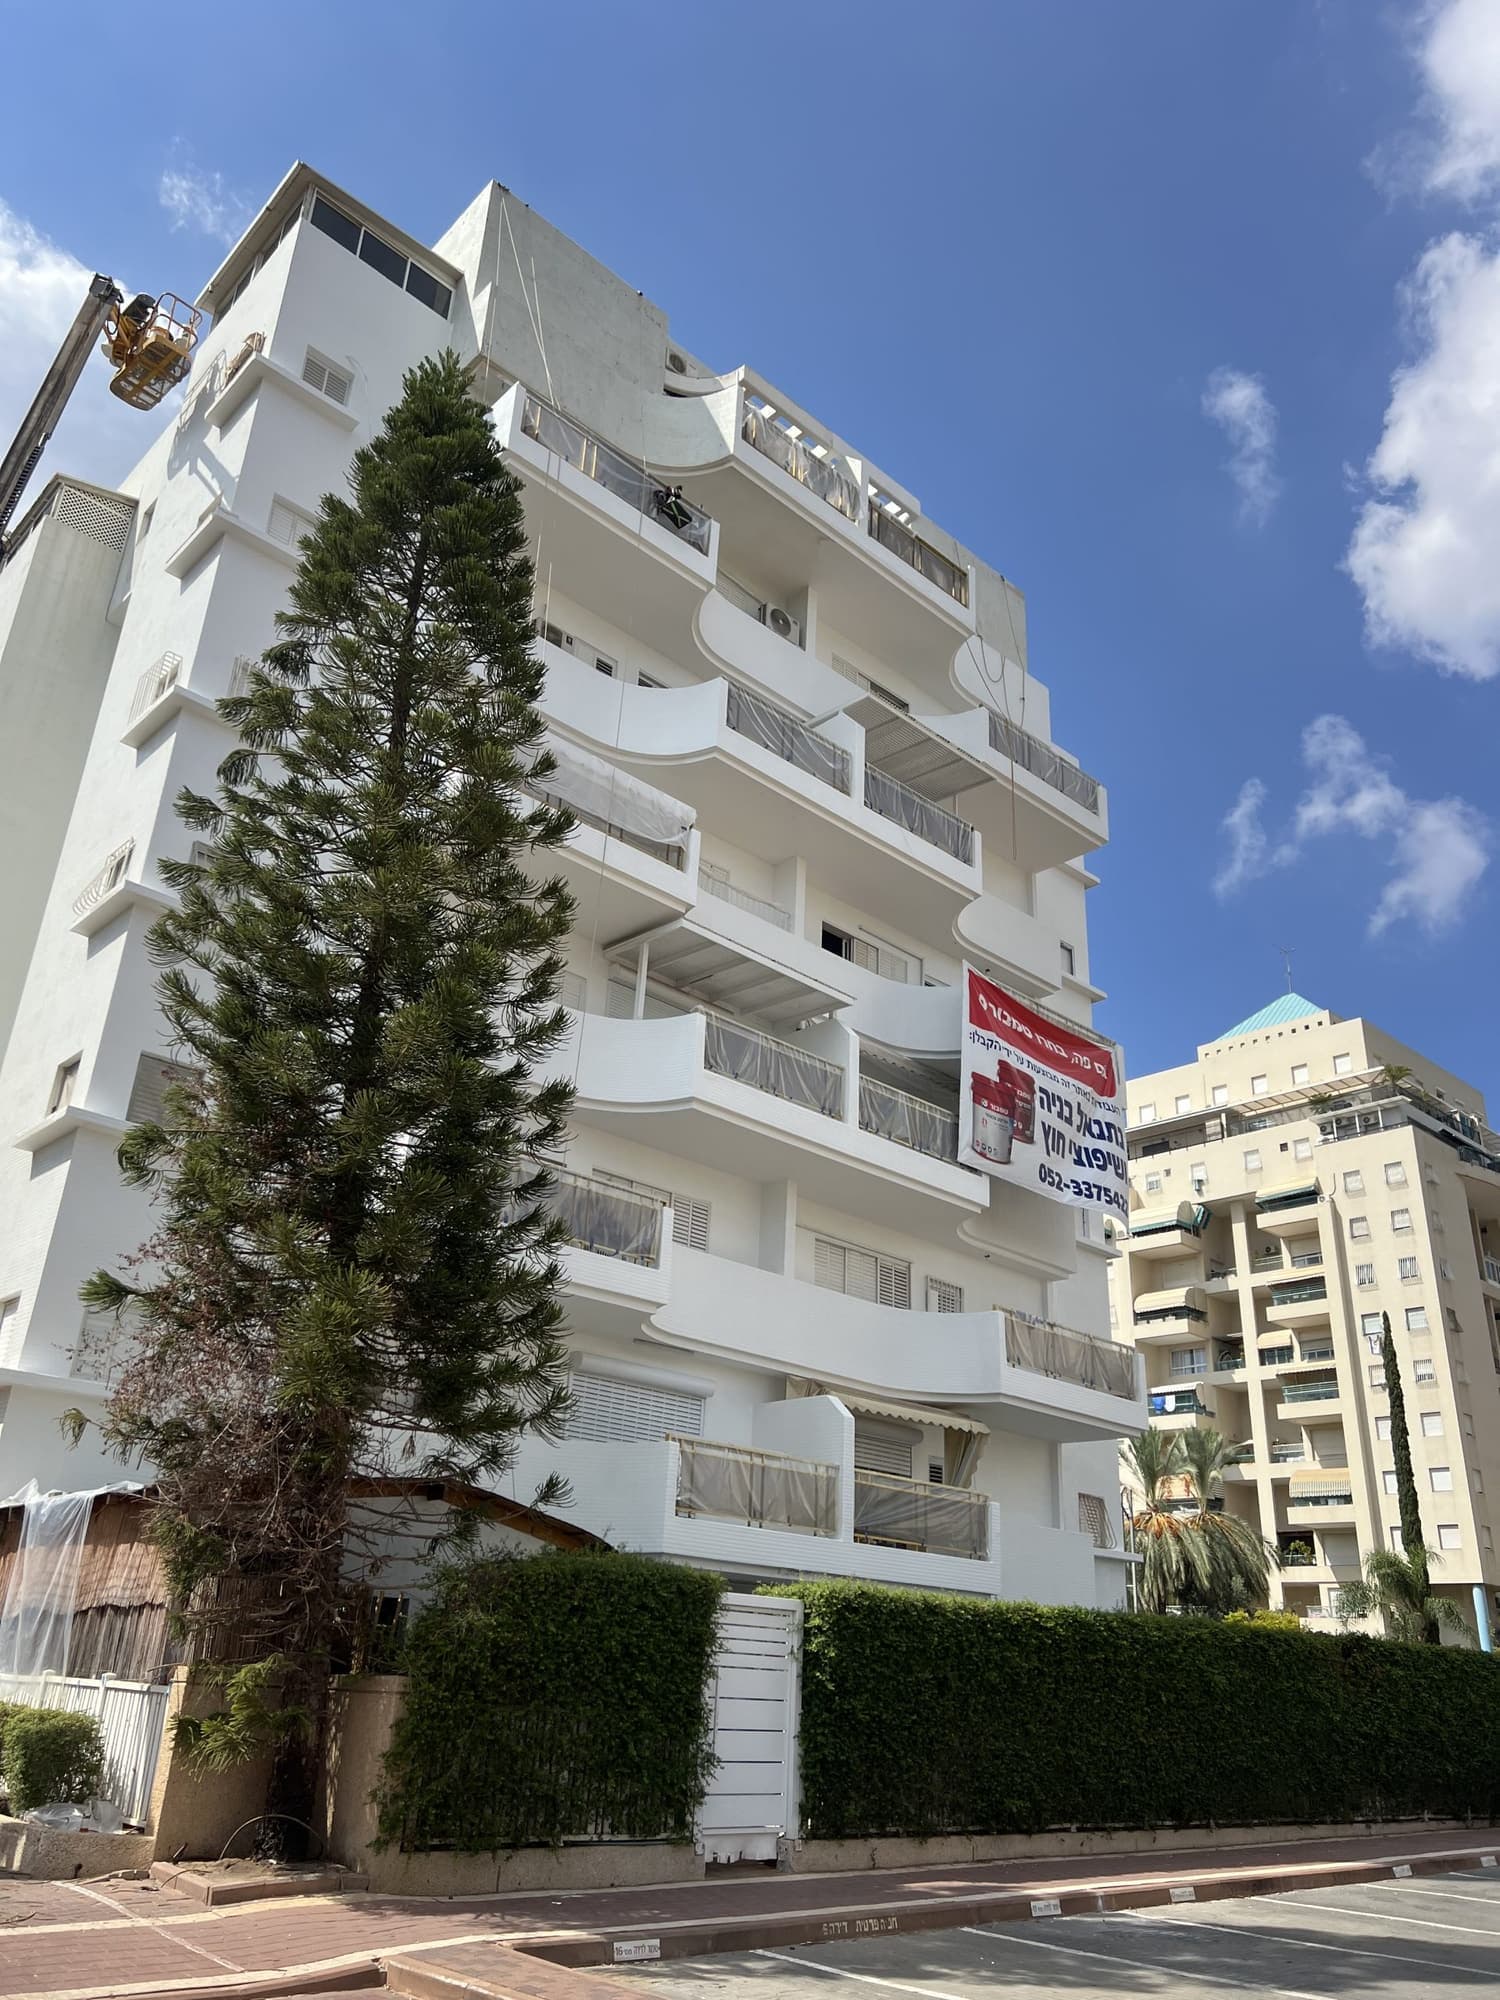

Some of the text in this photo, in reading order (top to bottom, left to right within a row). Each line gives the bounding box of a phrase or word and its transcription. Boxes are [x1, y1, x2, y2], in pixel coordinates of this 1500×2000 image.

[988, 1002, 1034, 1039] טמבור
[969, 1029, 1002, 1051] הקבלן:
[1035, 1034, 1068, 1058] בחרו
[1013, 1050, 1024, 1065] על
[1026, 1059, 1060, 1083] מבוצעות
[1061, 1078, 1070, 1088] זה
[1038, 1086, 1073, 1128] בניה
[1041, 1120, 1128, 1184] ושיפוצי חוץ
[1038, 1162, 1128, 1218] 052-3375422
[829, 1921, 848, 1935] דירה
